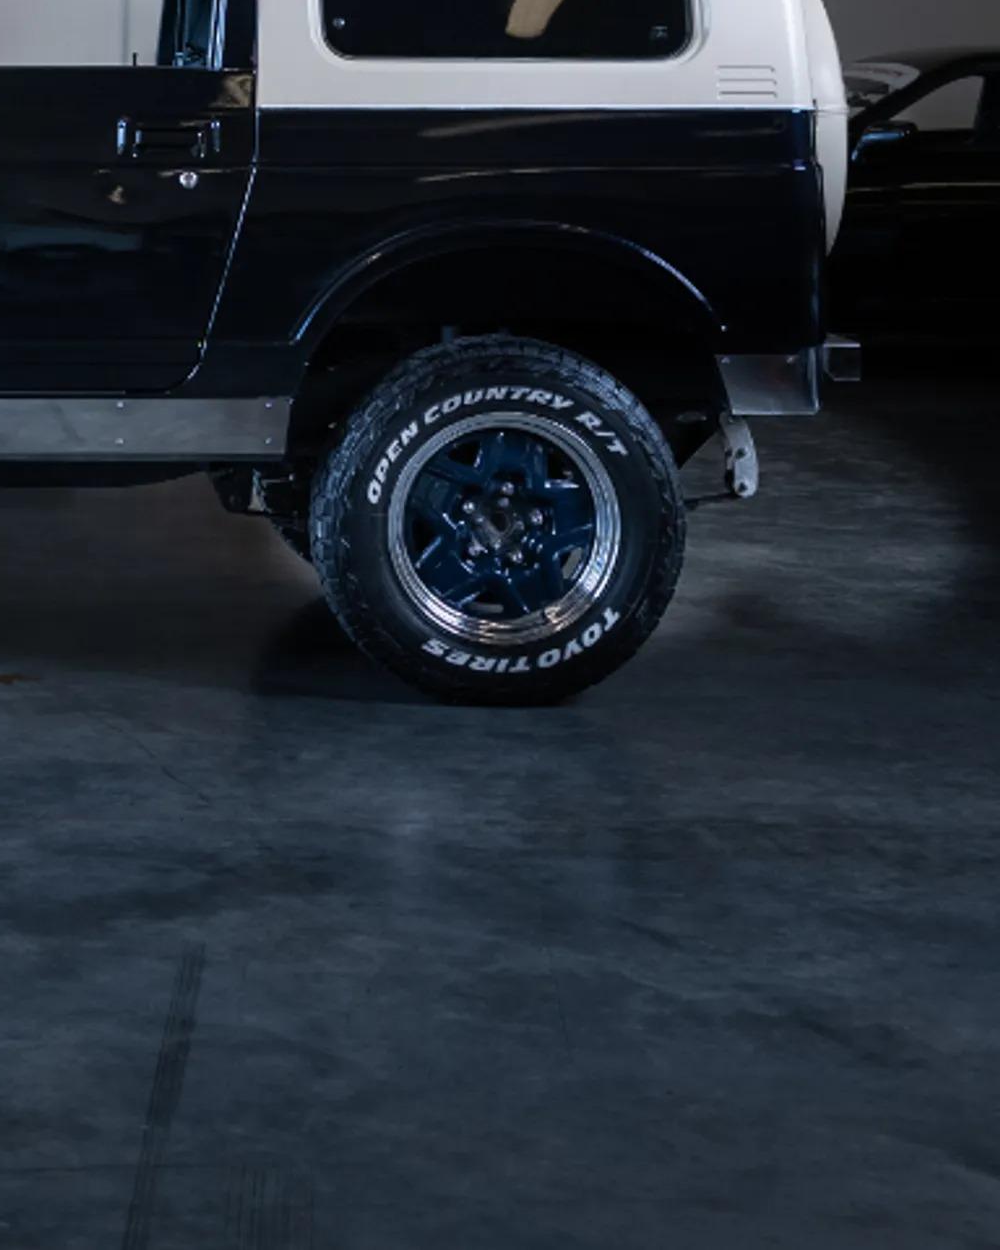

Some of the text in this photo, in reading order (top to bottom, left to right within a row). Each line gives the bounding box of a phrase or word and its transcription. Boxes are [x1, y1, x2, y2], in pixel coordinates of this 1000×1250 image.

[367, 385, 628, 505] OPEN COUNTRY R/T
[420, 607, 621, 673] TOYO TIRES
